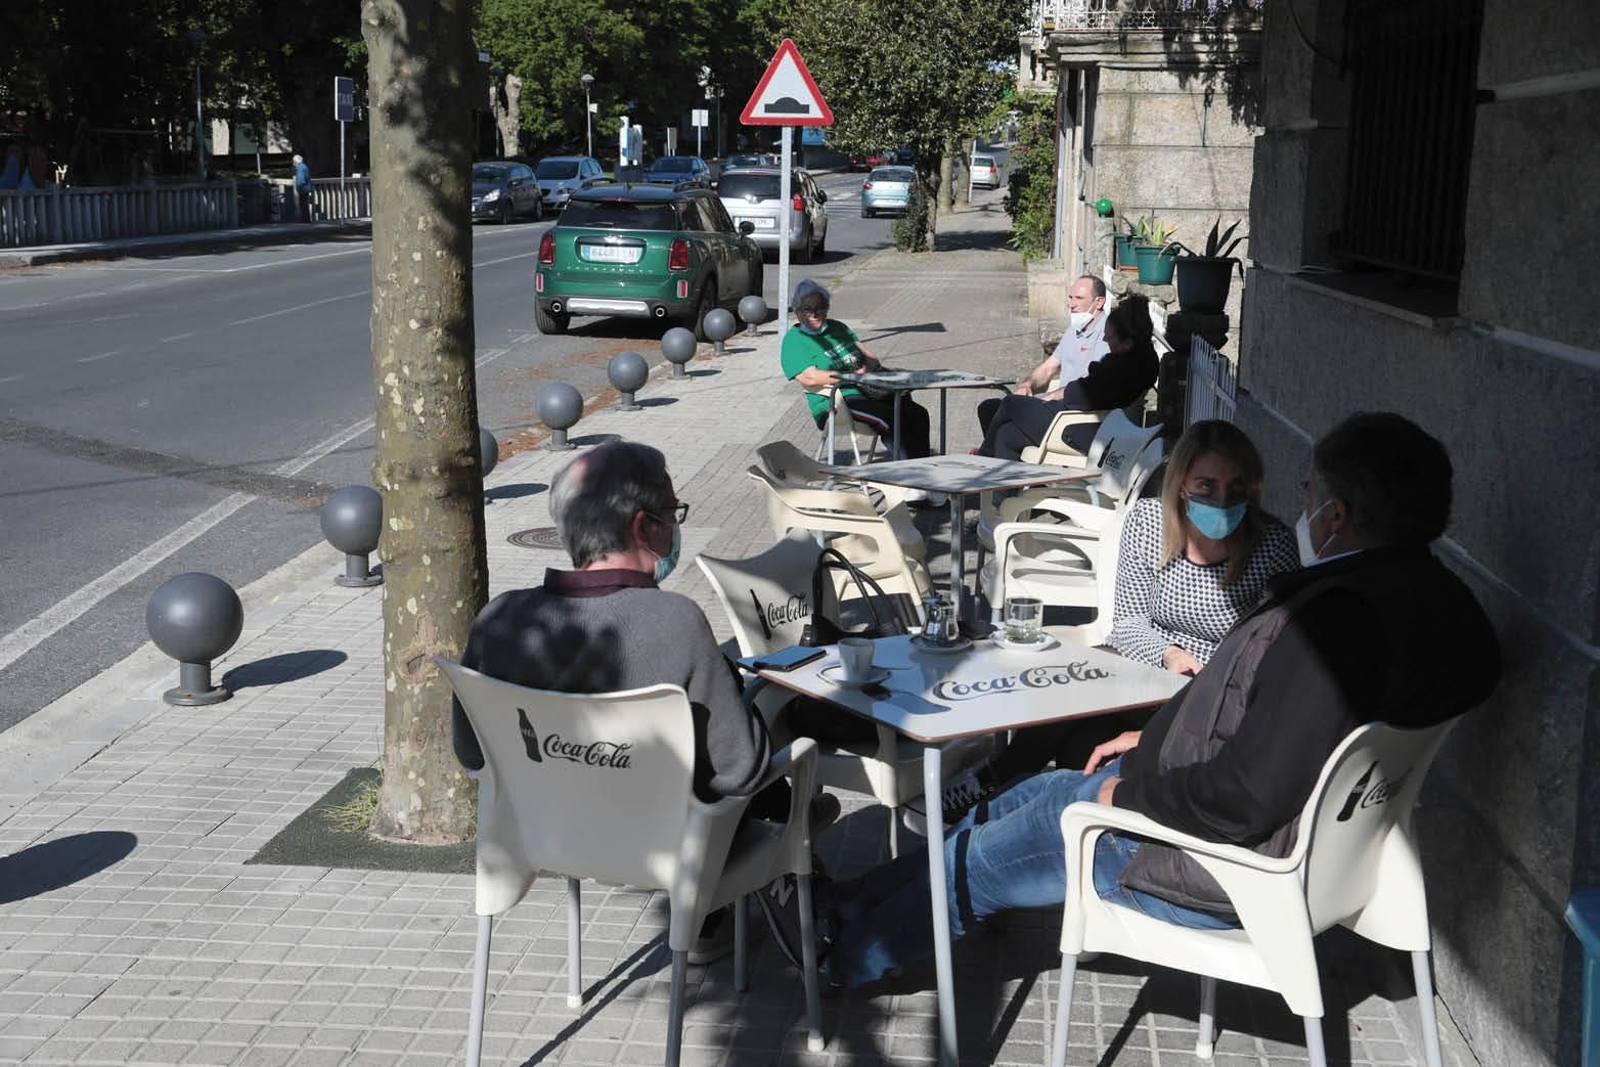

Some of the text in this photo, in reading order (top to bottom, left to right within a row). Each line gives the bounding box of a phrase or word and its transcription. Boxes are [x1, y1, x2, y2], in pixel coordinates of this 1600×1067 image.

[768, 592, 808, 628] Coca-Cola
[932, 660, 1109, 701] Coca-Cola
[543, 733, 632, 768] Coca-Cola
